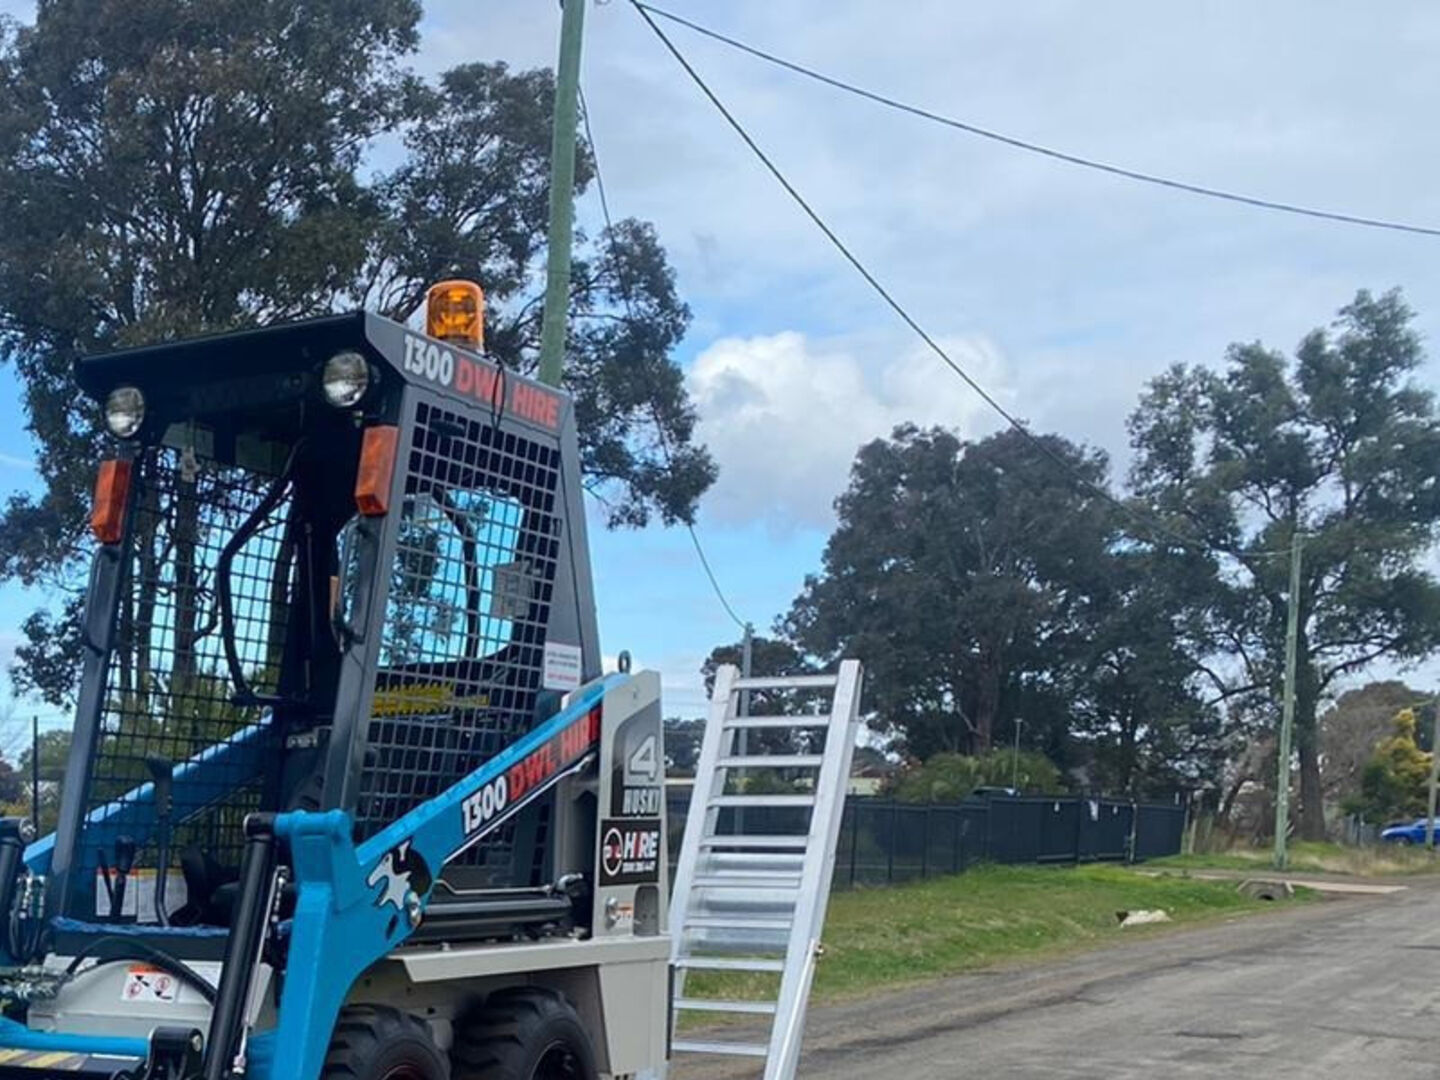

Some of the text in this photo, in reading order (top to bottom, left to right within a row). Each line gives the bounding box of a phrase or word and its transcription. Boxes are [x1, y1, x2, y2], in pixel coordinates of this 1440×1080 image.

[404, 334, 453, 386] 1300
[512, 381, 559, 429] HIRE
[462, 775, 507, 834] 1300
[511, 742, 557, 801] DWL
[629, 735, 657, 781] 4
